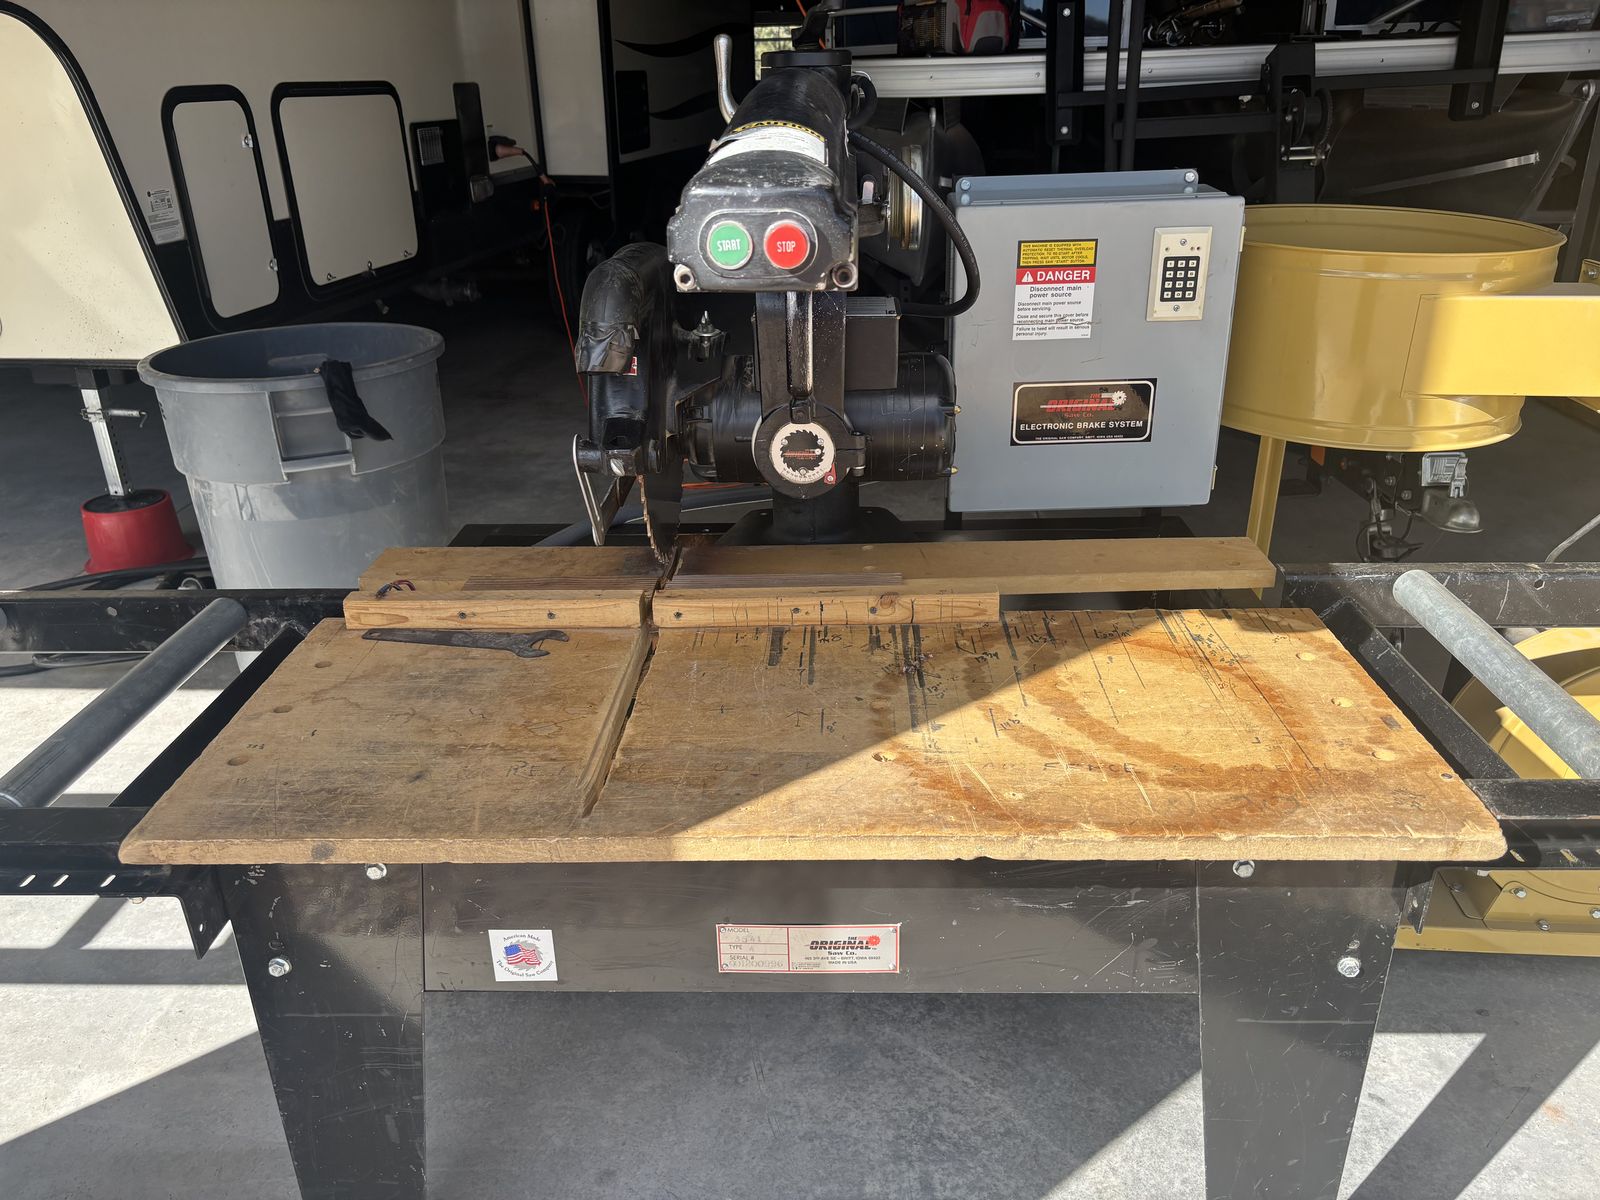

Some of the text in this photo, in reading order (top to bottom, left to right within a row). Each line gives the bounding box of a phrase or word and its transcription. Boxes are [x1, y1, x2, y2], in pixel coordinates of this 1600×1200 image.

[716, 239, 741, 251] START
[776, 241, 796, 252] STOP
[1036, 270, 1090, 281] DANGER
[1020, 422, 1074, 431] ELECTRONIC
[810, 940, 871, 950] ORIGINAL
[504, 967, 524, 976] Original
[536, 960, 554, 975] Company
